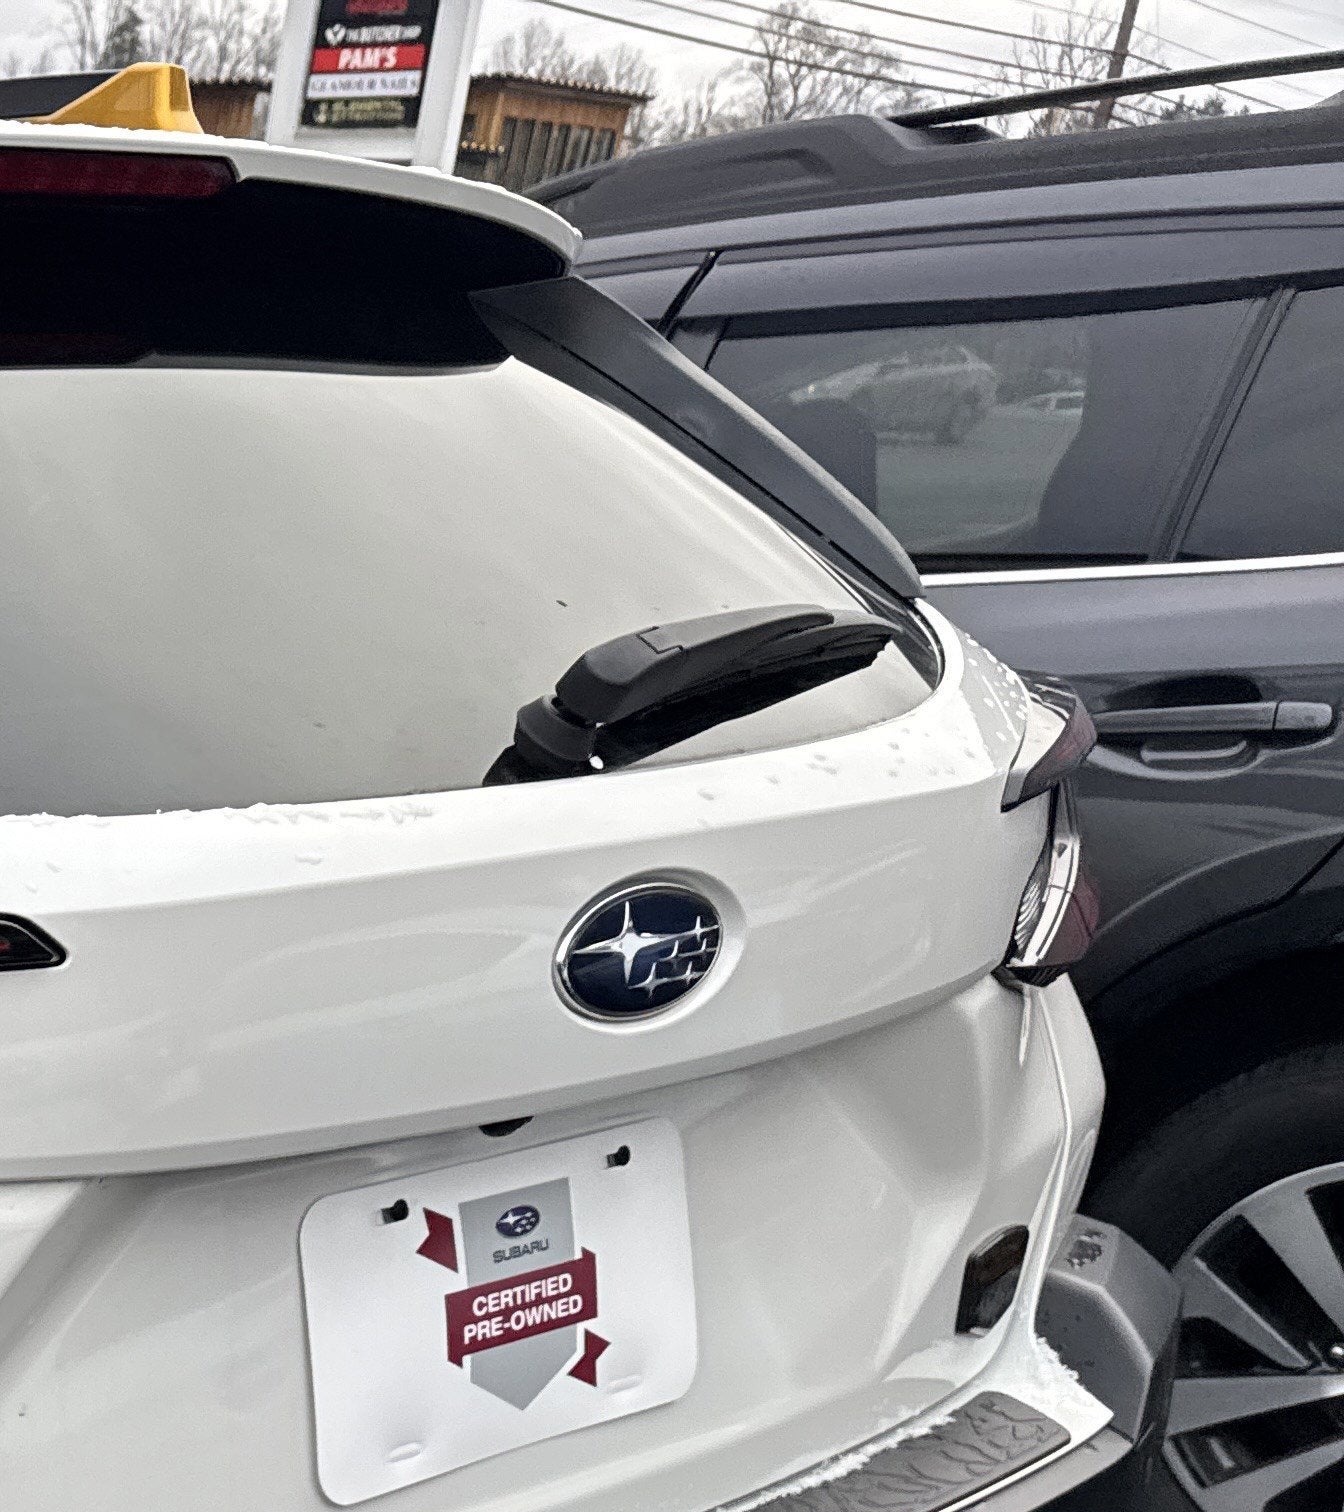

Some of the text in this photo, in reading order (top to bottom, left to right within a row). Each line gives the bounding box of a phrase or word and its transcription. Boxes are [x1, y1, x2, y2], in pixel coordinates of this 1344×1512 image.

[337, 46, 397, 70] PAM'S
[492, 1238, 550, 1264] SUBARU
[472, 1272, 573, 1317] CERTIFIED
[463, 1295, 583, 1345] PRE-OWNED
